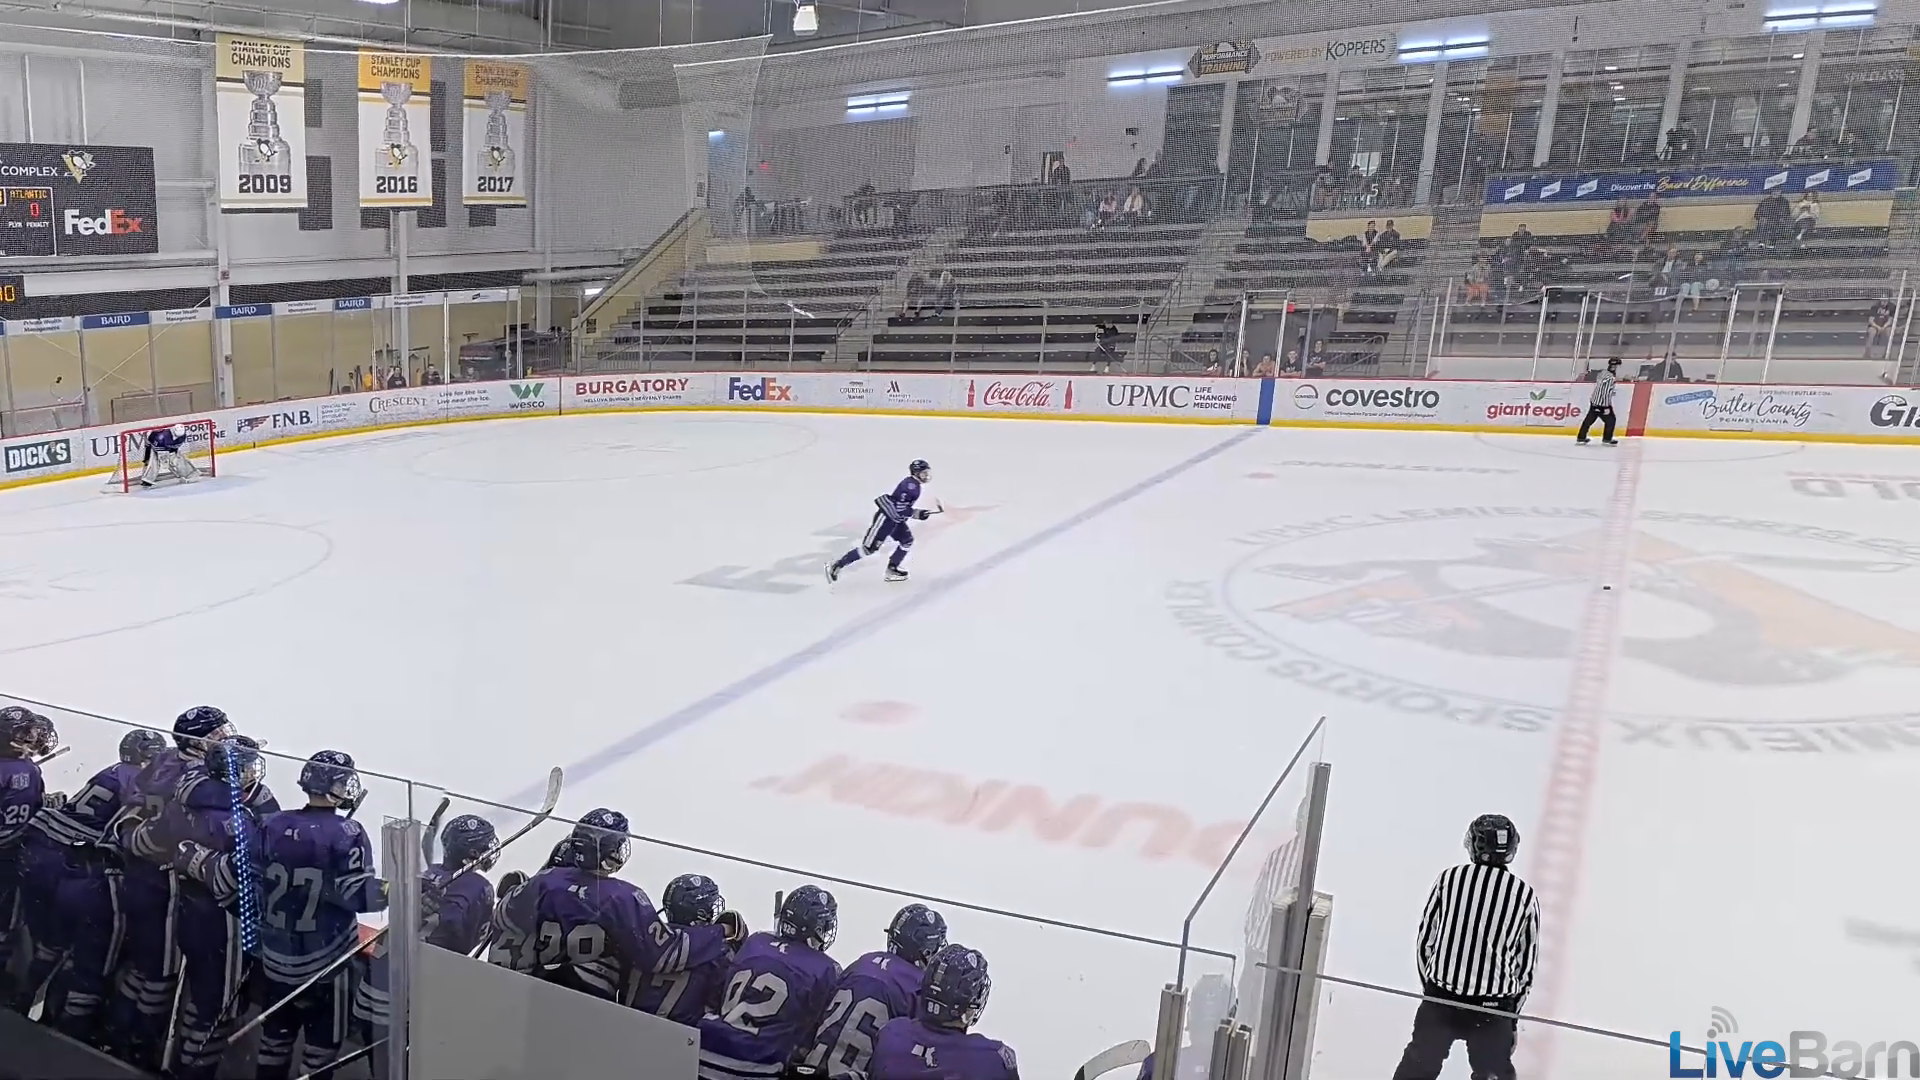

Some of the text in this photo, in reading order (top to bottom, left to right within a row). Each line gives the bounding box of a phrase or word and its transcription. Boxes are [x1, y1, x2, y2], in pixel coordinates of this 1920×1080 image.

[231, 41, 291, 56] STANLEY CUP
[1201, 51, 1248, 61] PERFORMANCE
[1326, 39, 1387, 60] KOPPERS
[231, 53, 291, 69] CHAMPIONS
[371, 55, 421, 68] STANLEY CUP
[371, 66, 420, 79] CHAMPIONS
[1, 167, 58, 176] COMPLEX
[239, 174, 291, 194] 2009
[376, 176, 418, 193] 2016
[477, 176, 514, 193] 2017
[1611, 184, 1641, 192] Discover
[1643, 182, 1655, 190] the
[10, 190, 48, 199] ATLANTIC
[64, 208, 144, 235] FedEx
[231, 306, 257, 316] BAIRD
[339, 298, 365, 308] BAIRD
[101, 315, 131, 325] BAIRD
[575, 379, 689, 396] BURGATORY
[728, 377, 792, 401] FedEx
[983, 380, 1055, 407] Coca-Cola
[1194, 386, 1212, 394] LIFE
[1106, 384, 1191, 408] UPMC
[1194, 394, 1238, 402] CHANGING
[1325, 386, 1440, 408] covestro
[369, 397, 428, 414] CRESCENT
[509, 400, 545, 409] wesco
[1193, 402, 1232, 410] MEDICINE
[1487, 402, 1581, 420] giant eagle
[1699, 393, 1812, 427] Butler County
[184, 422, 217, 432] PORTS
[273, 410, 313, 428] F.N.B.
[186, 430, 226, 442] EDICNE
[9, 441, 68, 469] DICK'S
[5, 803, 30, 825] 29
[265, 862, 324, 932] 27
[927, 1002, 940, 1015] 88
[804, 988, 890, 1076] 26
